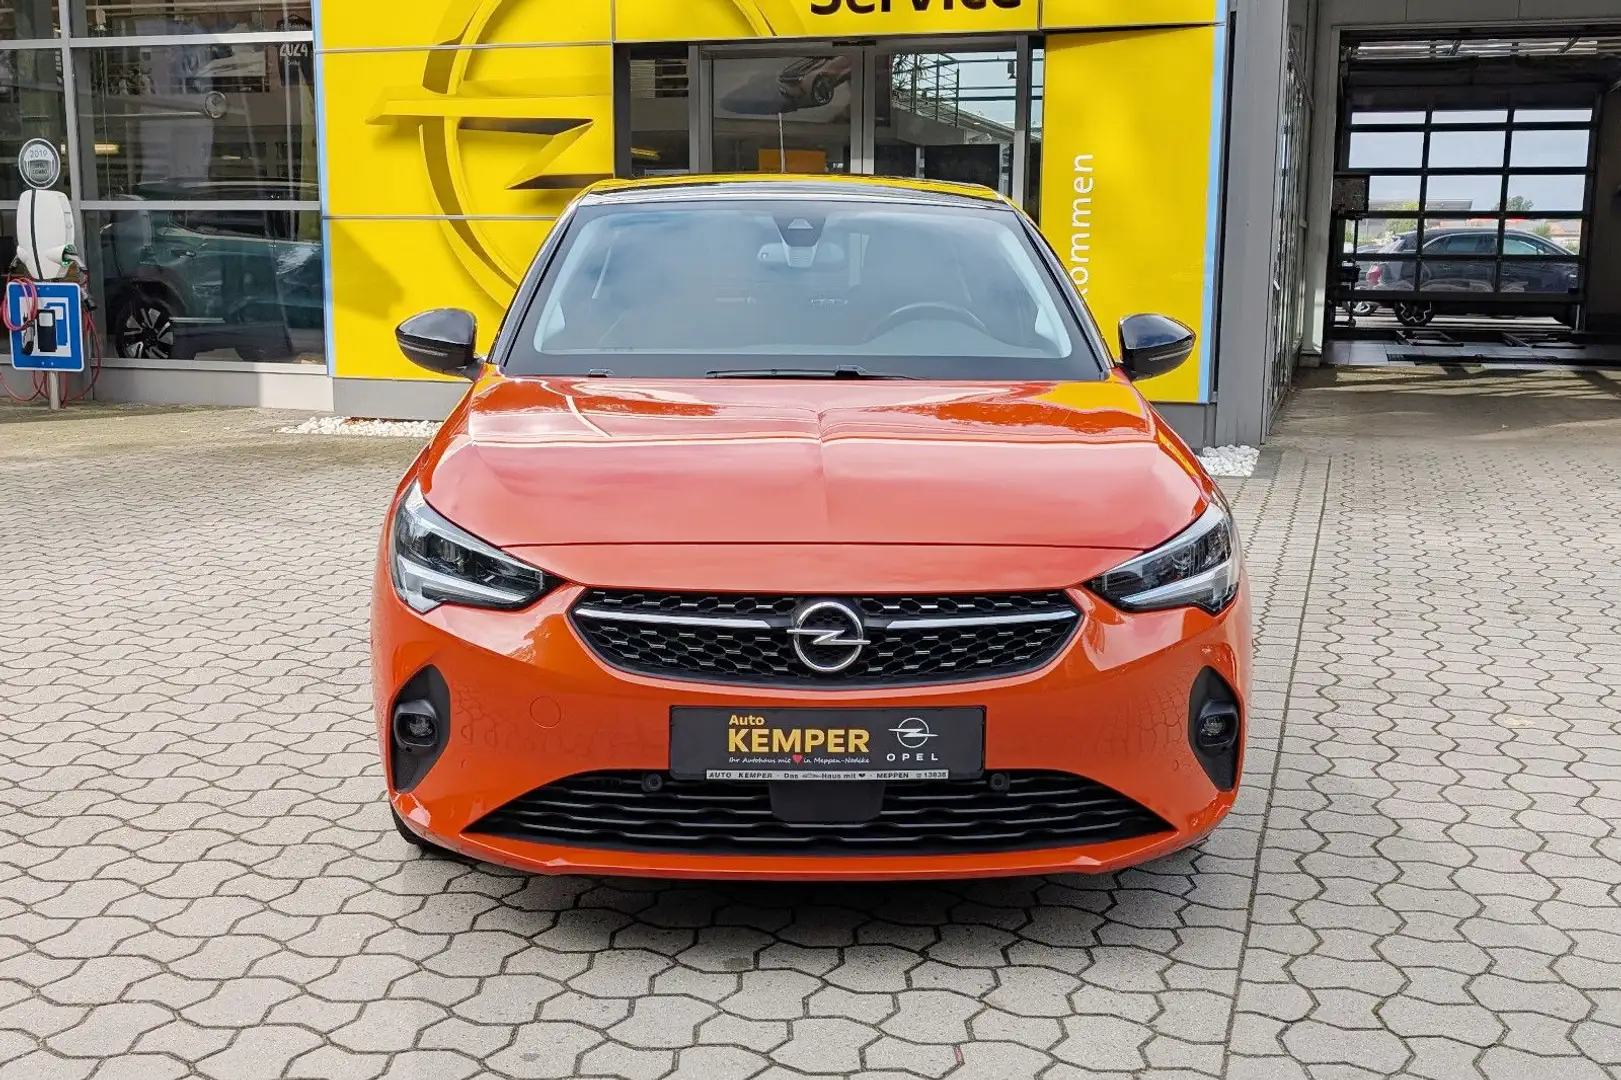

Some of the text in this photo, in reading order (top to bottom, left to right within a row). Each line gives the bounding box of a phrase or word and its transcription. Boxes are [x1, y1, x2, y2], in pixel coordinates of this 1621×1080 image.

[1070, 153, 1094, 297] ommen
[729, 714, 765, 726] Auto
[728, 728, 870, 752] KEMPER
[742, 756, 776, 764] Autohaus
[886, 752, 939, 762] OPEL
[709, 771, 732, 779] AUTO
[738, 771, 774, 779] KEMPER
[876, 771, 909, 779] MEPPEN
